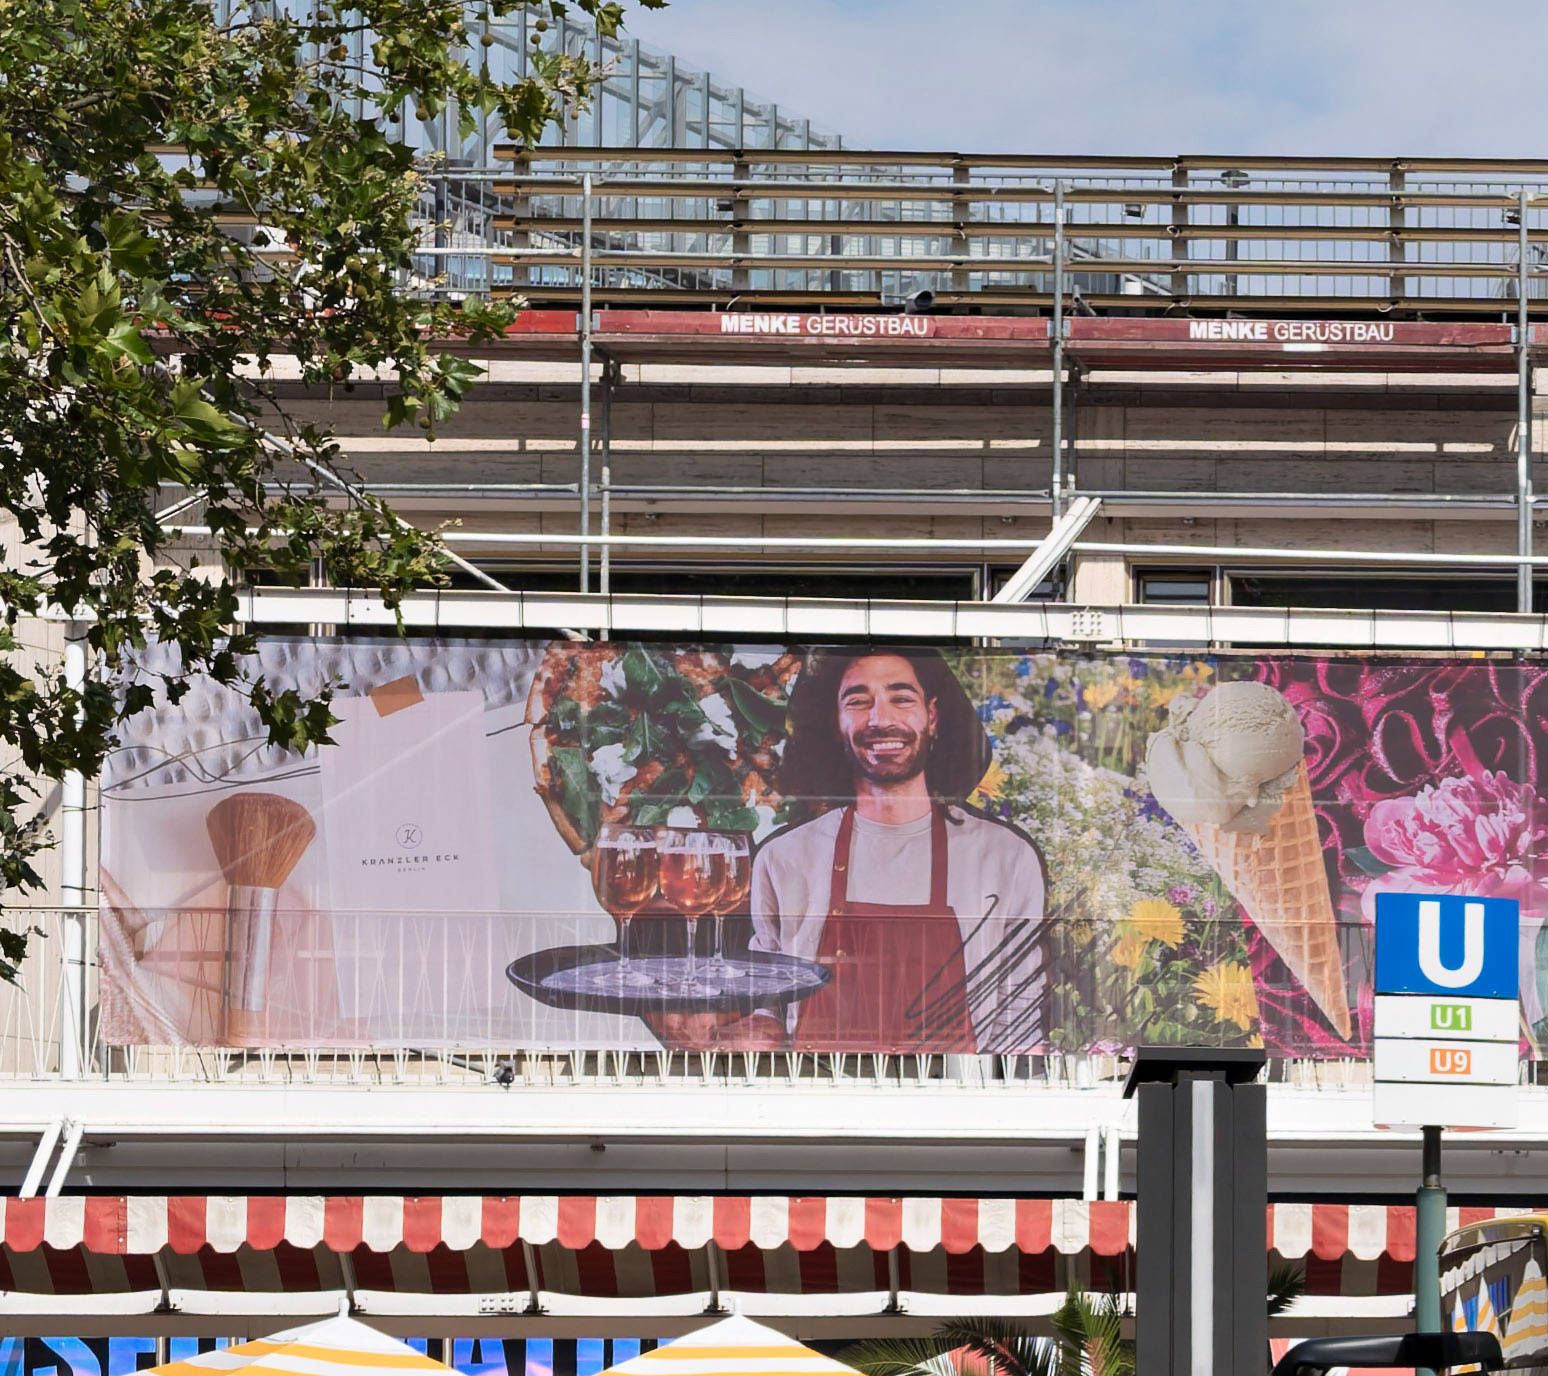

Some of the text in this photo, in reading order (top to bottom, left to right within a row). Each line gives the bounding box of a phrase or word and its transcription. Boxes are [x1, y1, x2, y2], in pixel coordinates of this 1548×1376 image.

[720, 314, 928, 336] MENKE GERÜSTBAU
[1190, 322, 1394, 341] MENKE GERÜSTBAU
[361, 854, 459, 866] KRANZLER ECK
[1418, 901, 1485, 988] U
[1434, 1006, 1467, 1028] U1
[1434, 1050, 1468, 1073] U9
